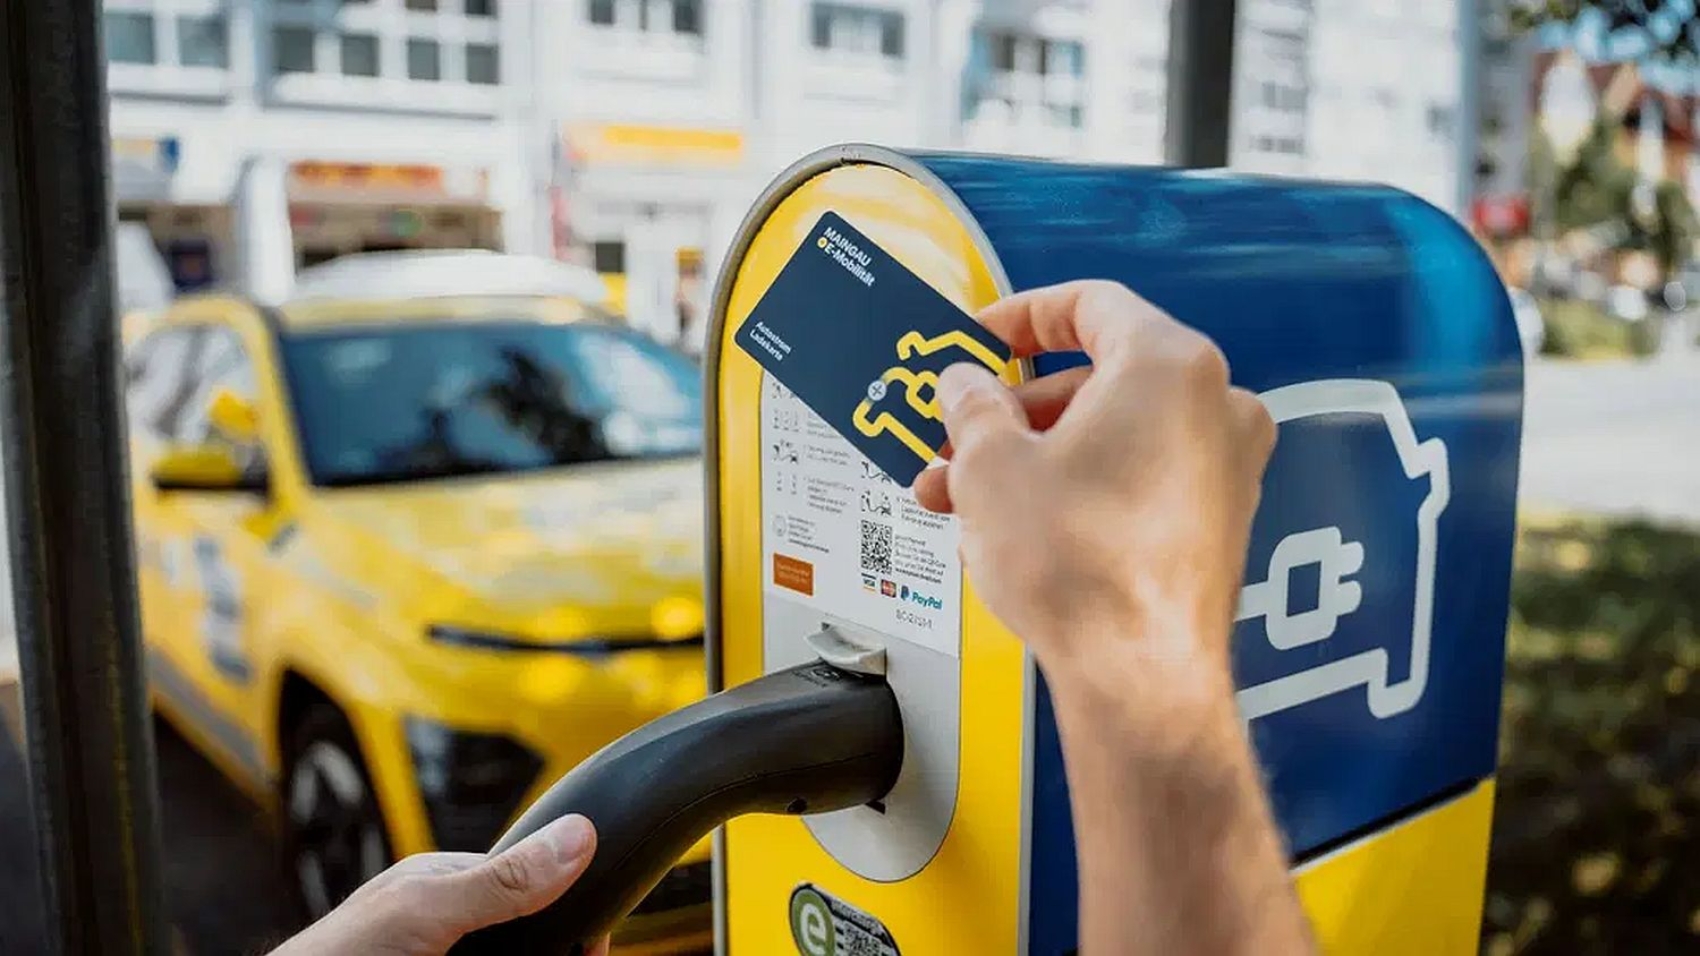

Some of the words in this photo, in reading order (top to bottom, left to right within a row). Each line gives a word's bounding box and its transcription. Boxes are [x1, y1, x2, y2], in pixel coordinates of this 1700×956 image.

[824, 227, 872, 266] MAINGAU
[824, 242, 875, 287] E-Mobilität
[750, 329, 783, 361] Ladekarte
[755, 321, 791, 354] Autostrom
[912, 591, 943, 610] PayPal
